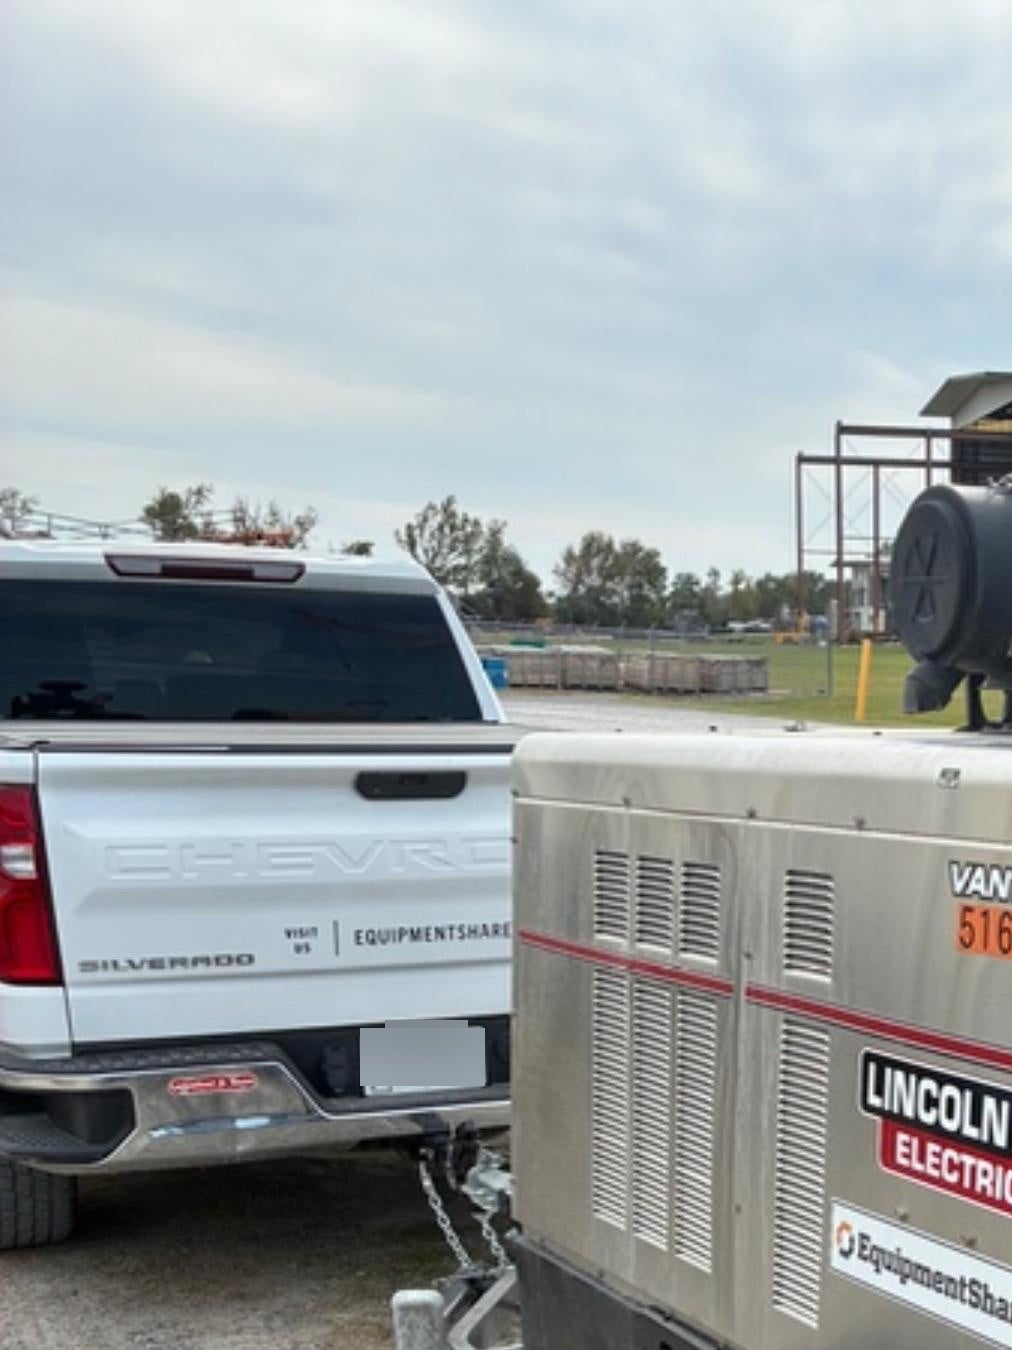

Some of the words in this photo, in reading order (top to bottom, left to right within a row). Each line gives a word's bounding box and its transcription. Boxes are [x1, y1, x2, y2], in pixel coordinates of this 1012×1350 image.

[104, 838, 511, 881] CHEVRO
[284, 926, 319, 940] VISIT
[293, 942, 311, 955] US
[77, 952, 256, 974] SILVERADO
[865, 1059, 1011, 1150] LINCOLN
